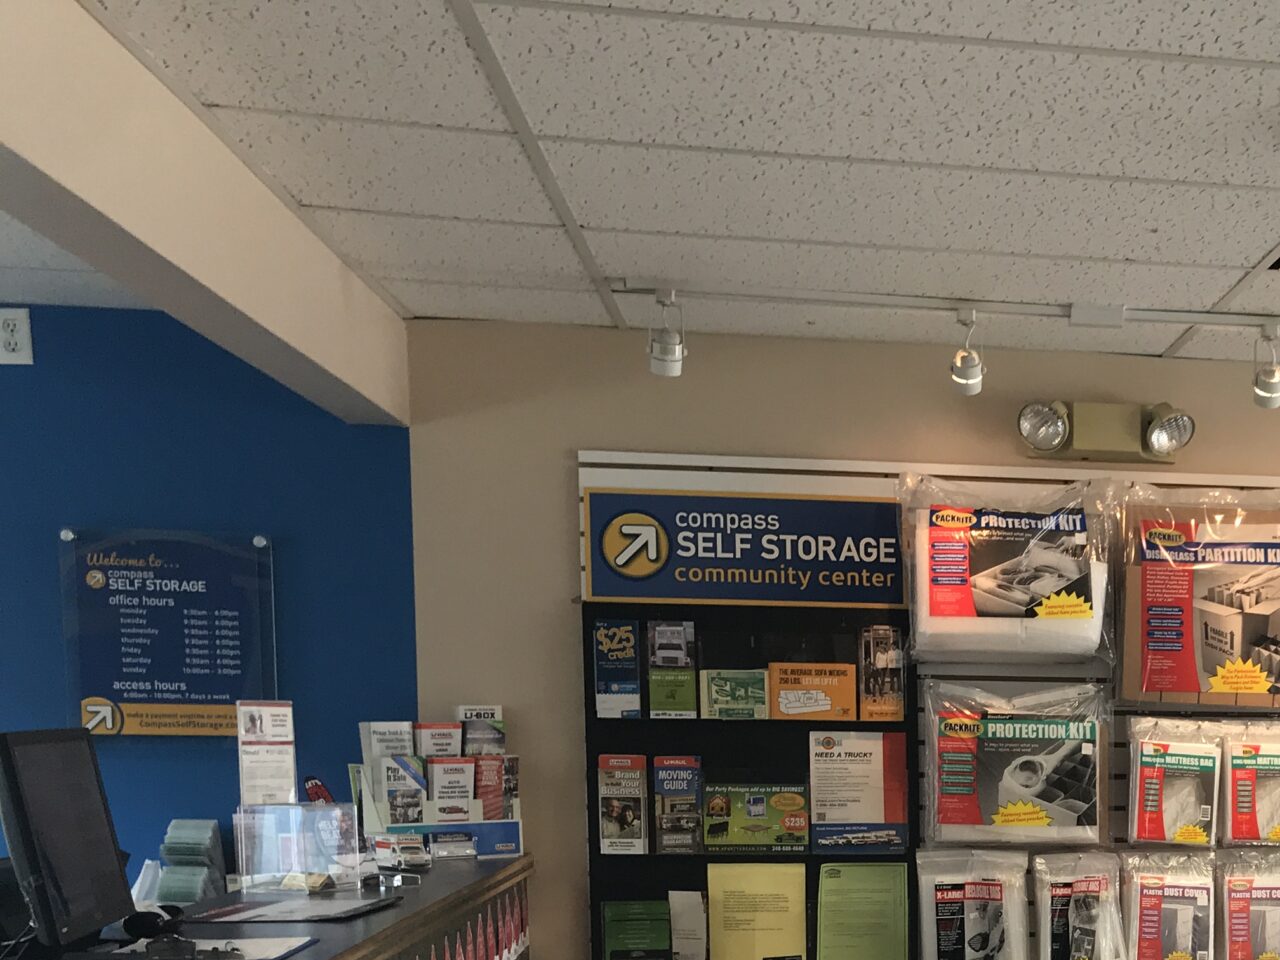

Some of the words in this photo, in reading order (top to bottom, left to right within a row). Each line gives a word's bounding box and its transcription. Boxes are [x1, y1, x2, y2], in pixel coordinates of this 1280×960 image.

[675, 511, 780, 534] compass
[935, 514, 973, 525] PACKRITE
[1059, 514, 1083, 531] KIT
[676, 531, 752, 559] SELF
[761, 534, 897, 563] STORAGE
[86, 552, 147, 567] Welcome
[1198, 548, 1265, 563] PARTITION
[108, 569, 155, 580] compass
[675, 563, 811, 589] community
[818, 569, 895, 587] center
[108, 578, 142, 591] SELF
[145, 579, 207, 593] STORAGE
[109, 595, 140, 606] office
[142, 595, 175, 607] hours
[120, 608, 147, 616] monday
[120, 617, 147, 625] tuesday
[597, 625, 636, 653] $25
[608, 647, 636, 660] credit
[779, 668, 789, 676] THE
[790, 668, 813, 676] AVERAGE
[113, 681, 151, 690] access
[154, 680, 187, 691] hours
[943, 723, 981, 733] PACKRITE
[987, 722, 1067, 739] PROTECTION
[1069, 722, 1092, 739] KIT
[1165, 755, 1200, 766] MATTRESS
[1200, 757, 1213, 767] BAG
[615, 771, 640, 779] Brand
[659, 770, 693, 780] MOVING
[621, 779, 640, 787] Your
[664, 781, 688, 790] GUIDE
[601, 787, 640, 795] Business
[936, 890, 965, 900] X-LARGE
[1143, 888, 1163, 896] PLASTIC
[1164, 887, 1183, 897] DUST
[1184, 888, 1208, 898] COVER
